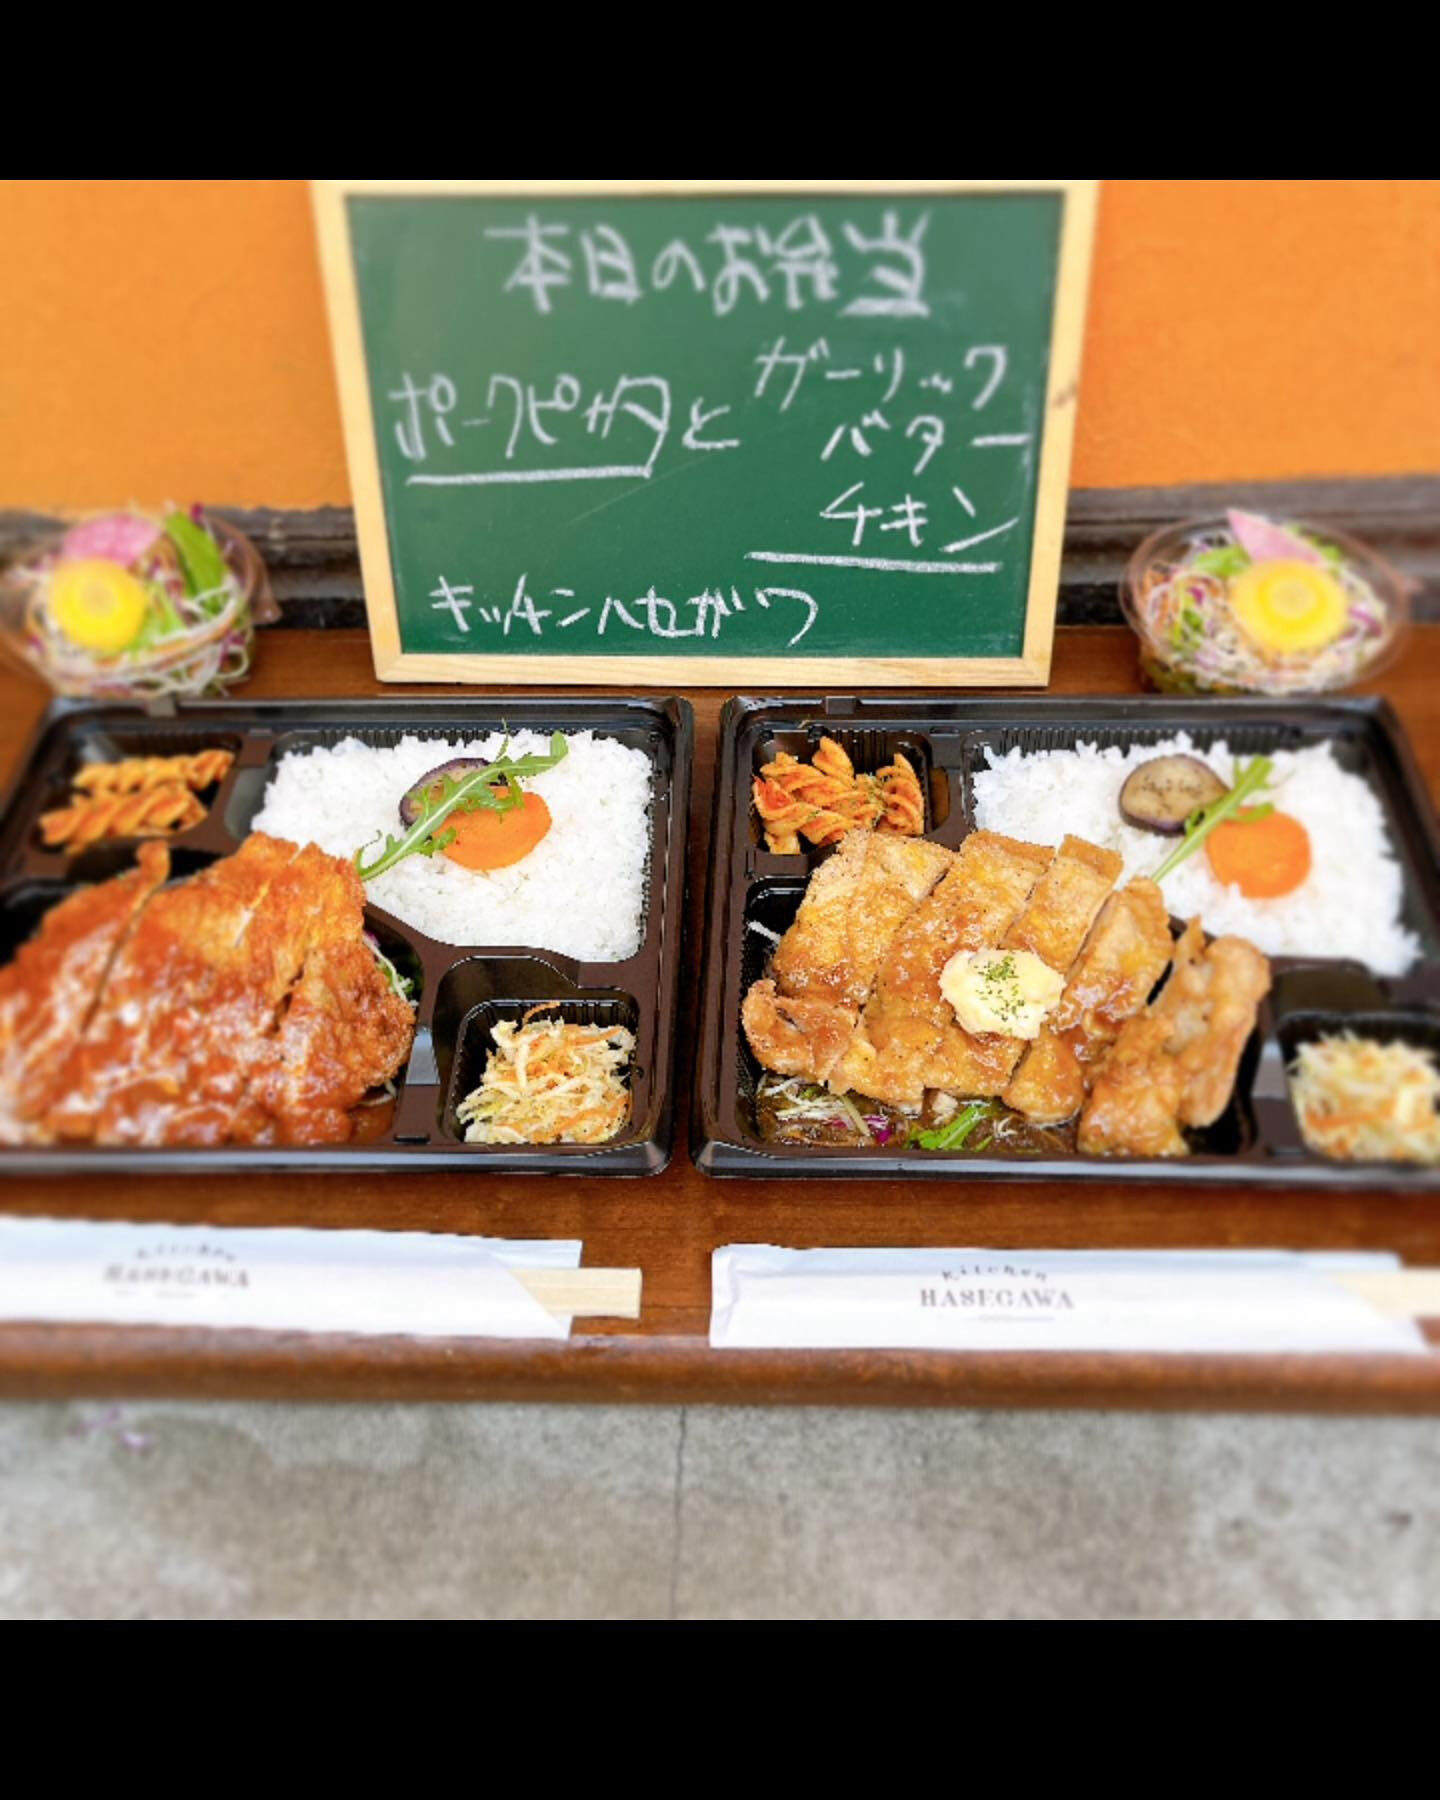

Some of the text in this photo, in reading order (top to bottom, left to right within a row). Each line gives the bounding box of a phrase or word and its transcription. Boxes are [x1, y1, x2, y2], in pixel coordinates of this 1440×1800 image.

[484, 209, 935, 317] 本日のお弁当
[755, 335, 1007, 412] ガーリック
[820, 410, 1031, 474] バター
[820, 481, 1019, 552] チキン
[920, 1288, 1075, 1309] HASEGAWA
